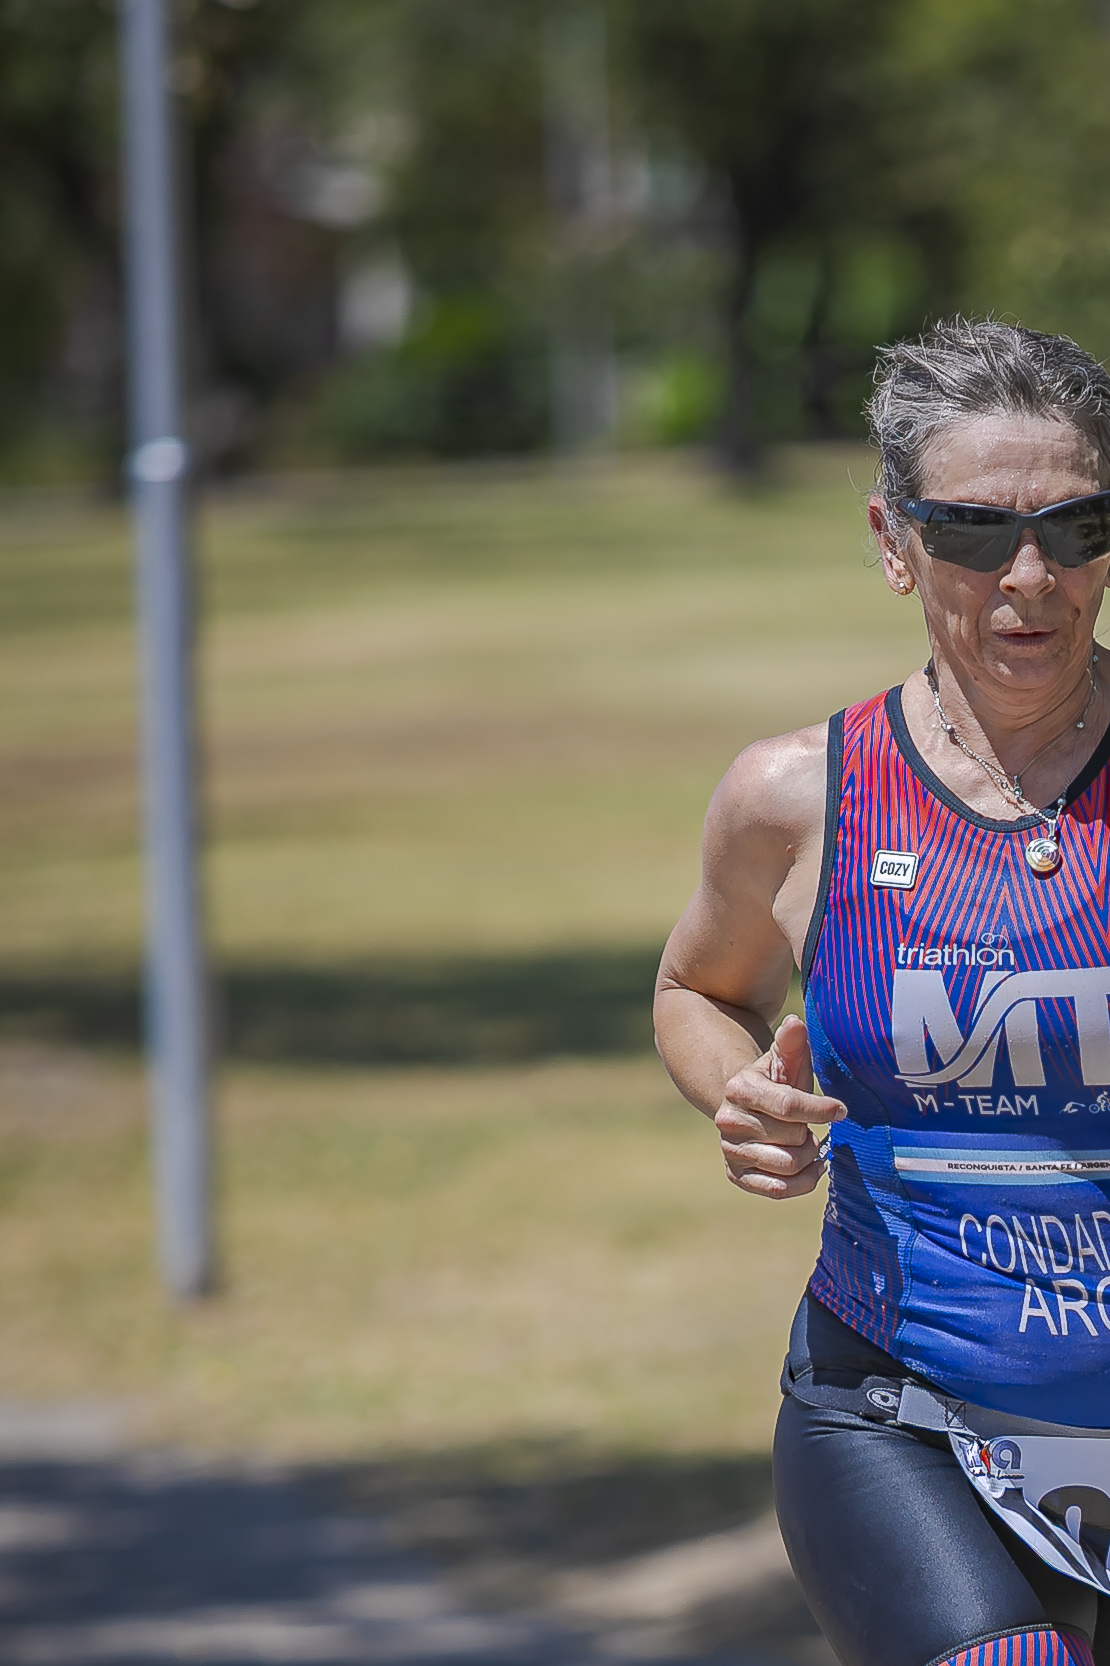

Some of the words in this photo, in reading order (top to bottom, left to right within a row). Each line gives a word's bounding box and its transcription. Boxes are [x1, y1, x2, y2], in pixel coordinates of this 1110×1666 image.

[880, 861, 910, 876] COZY
[897, 942, 1015, 966] triathlon
[948, 1162, 1016, 1172] RECONQUISTA
[1025, 1163, 1059, 1172] SANTA
[1060, 1163, 1072, 1171] FE
